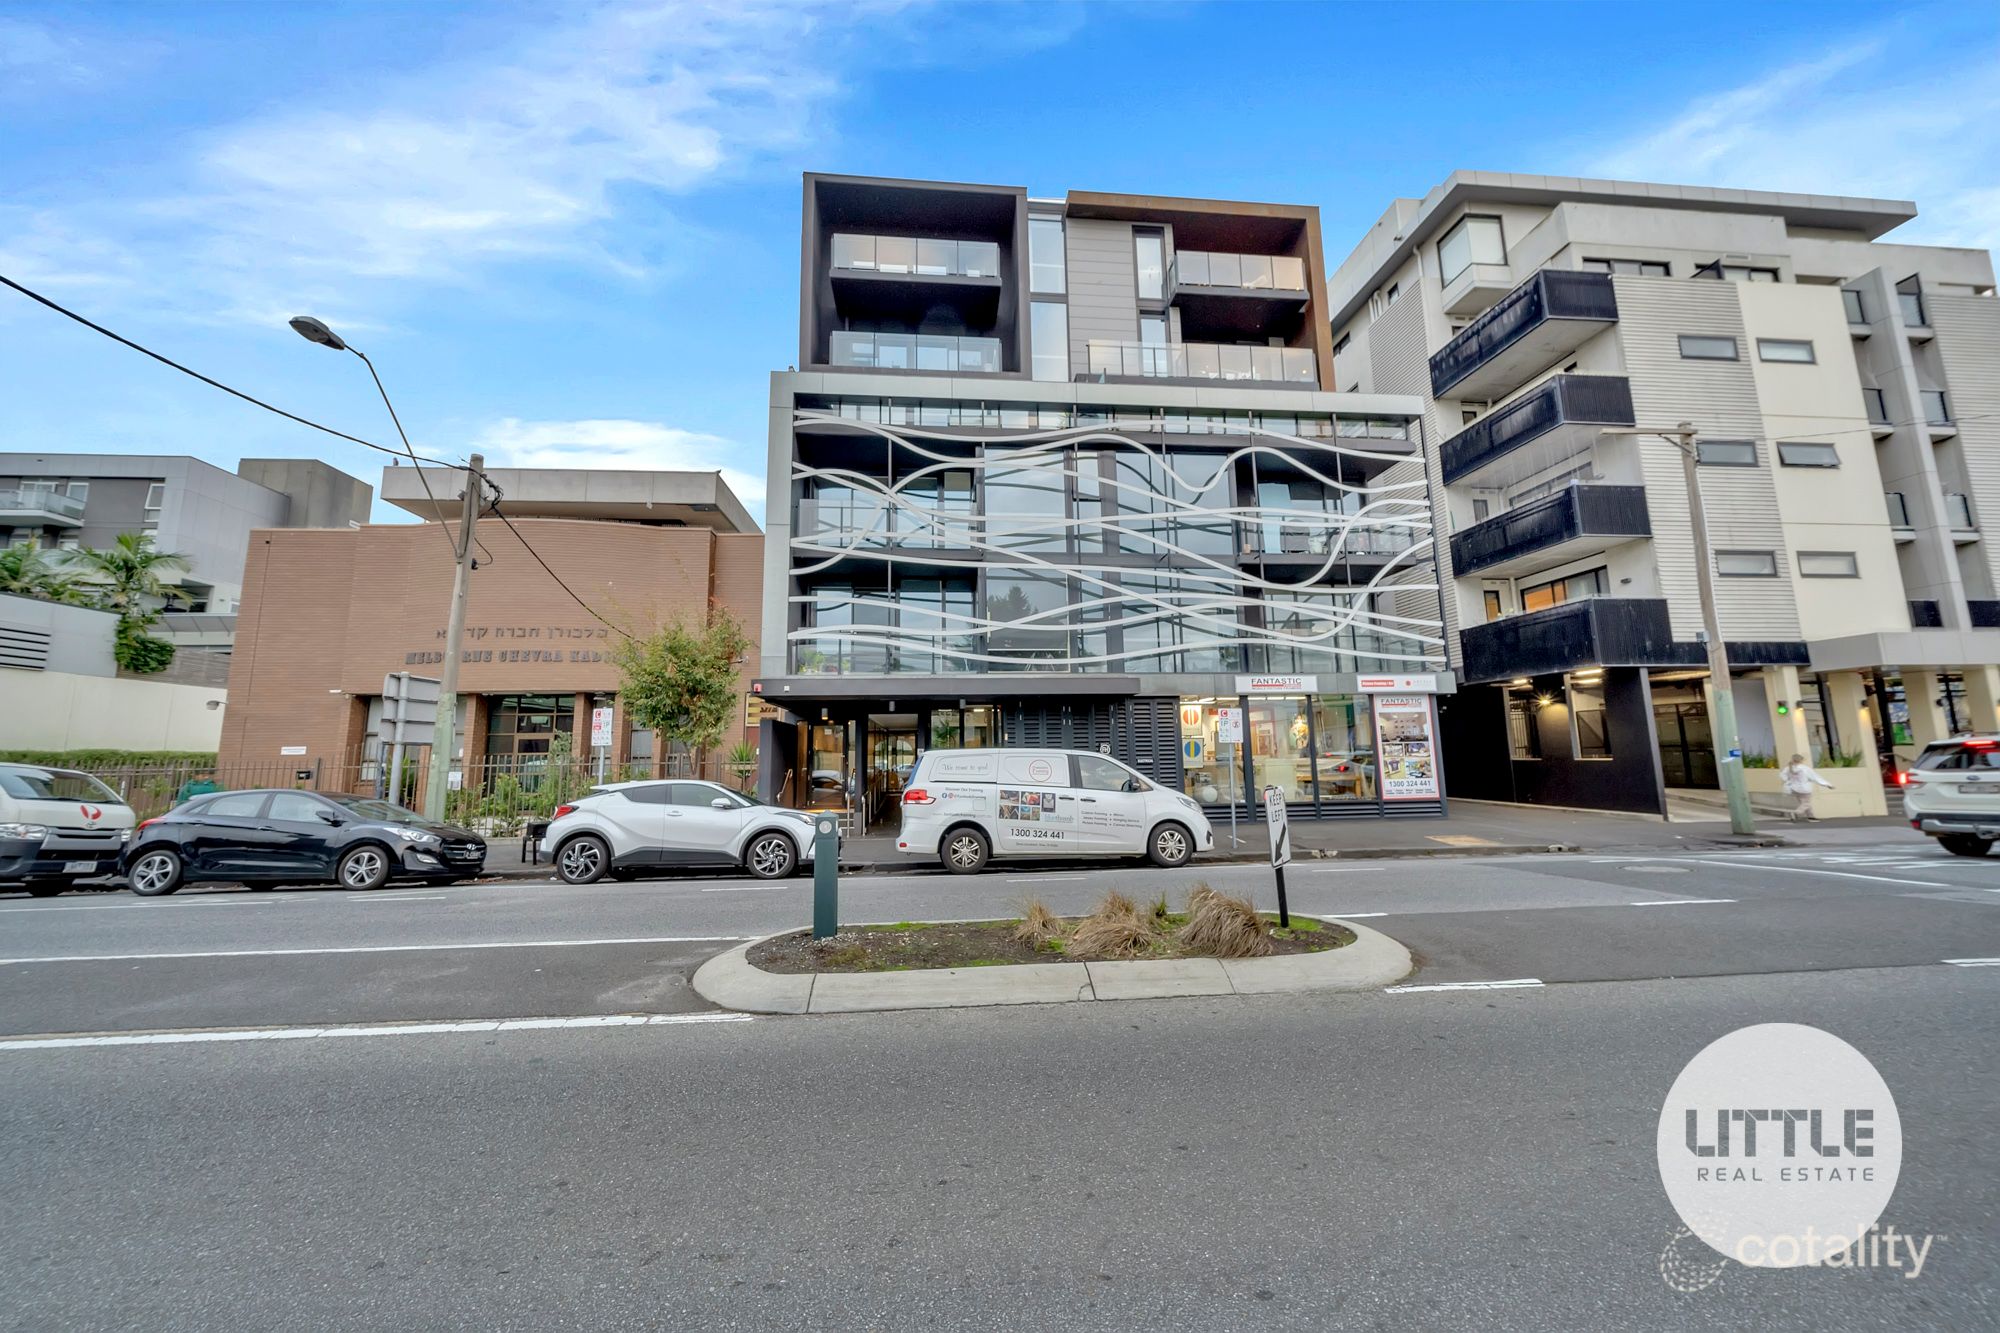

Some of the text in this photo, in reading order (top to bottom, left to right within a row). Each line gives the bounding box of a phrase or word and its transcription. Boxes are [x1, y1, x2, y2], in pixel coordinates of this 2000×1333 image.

[405, 650, 493, 664] MELBRNE
[499, 649, 563, 663] CHEVRA
[1251, 677, 1302, 685] FANTASTIC
[1380, 697, 1422, 705] FANTASTIC
[1270, 793, 1282, 806] KEEP
[1271, 809, 1283, 823] LEFT
[1011, 828, 1065, 839] 1300 324 441
